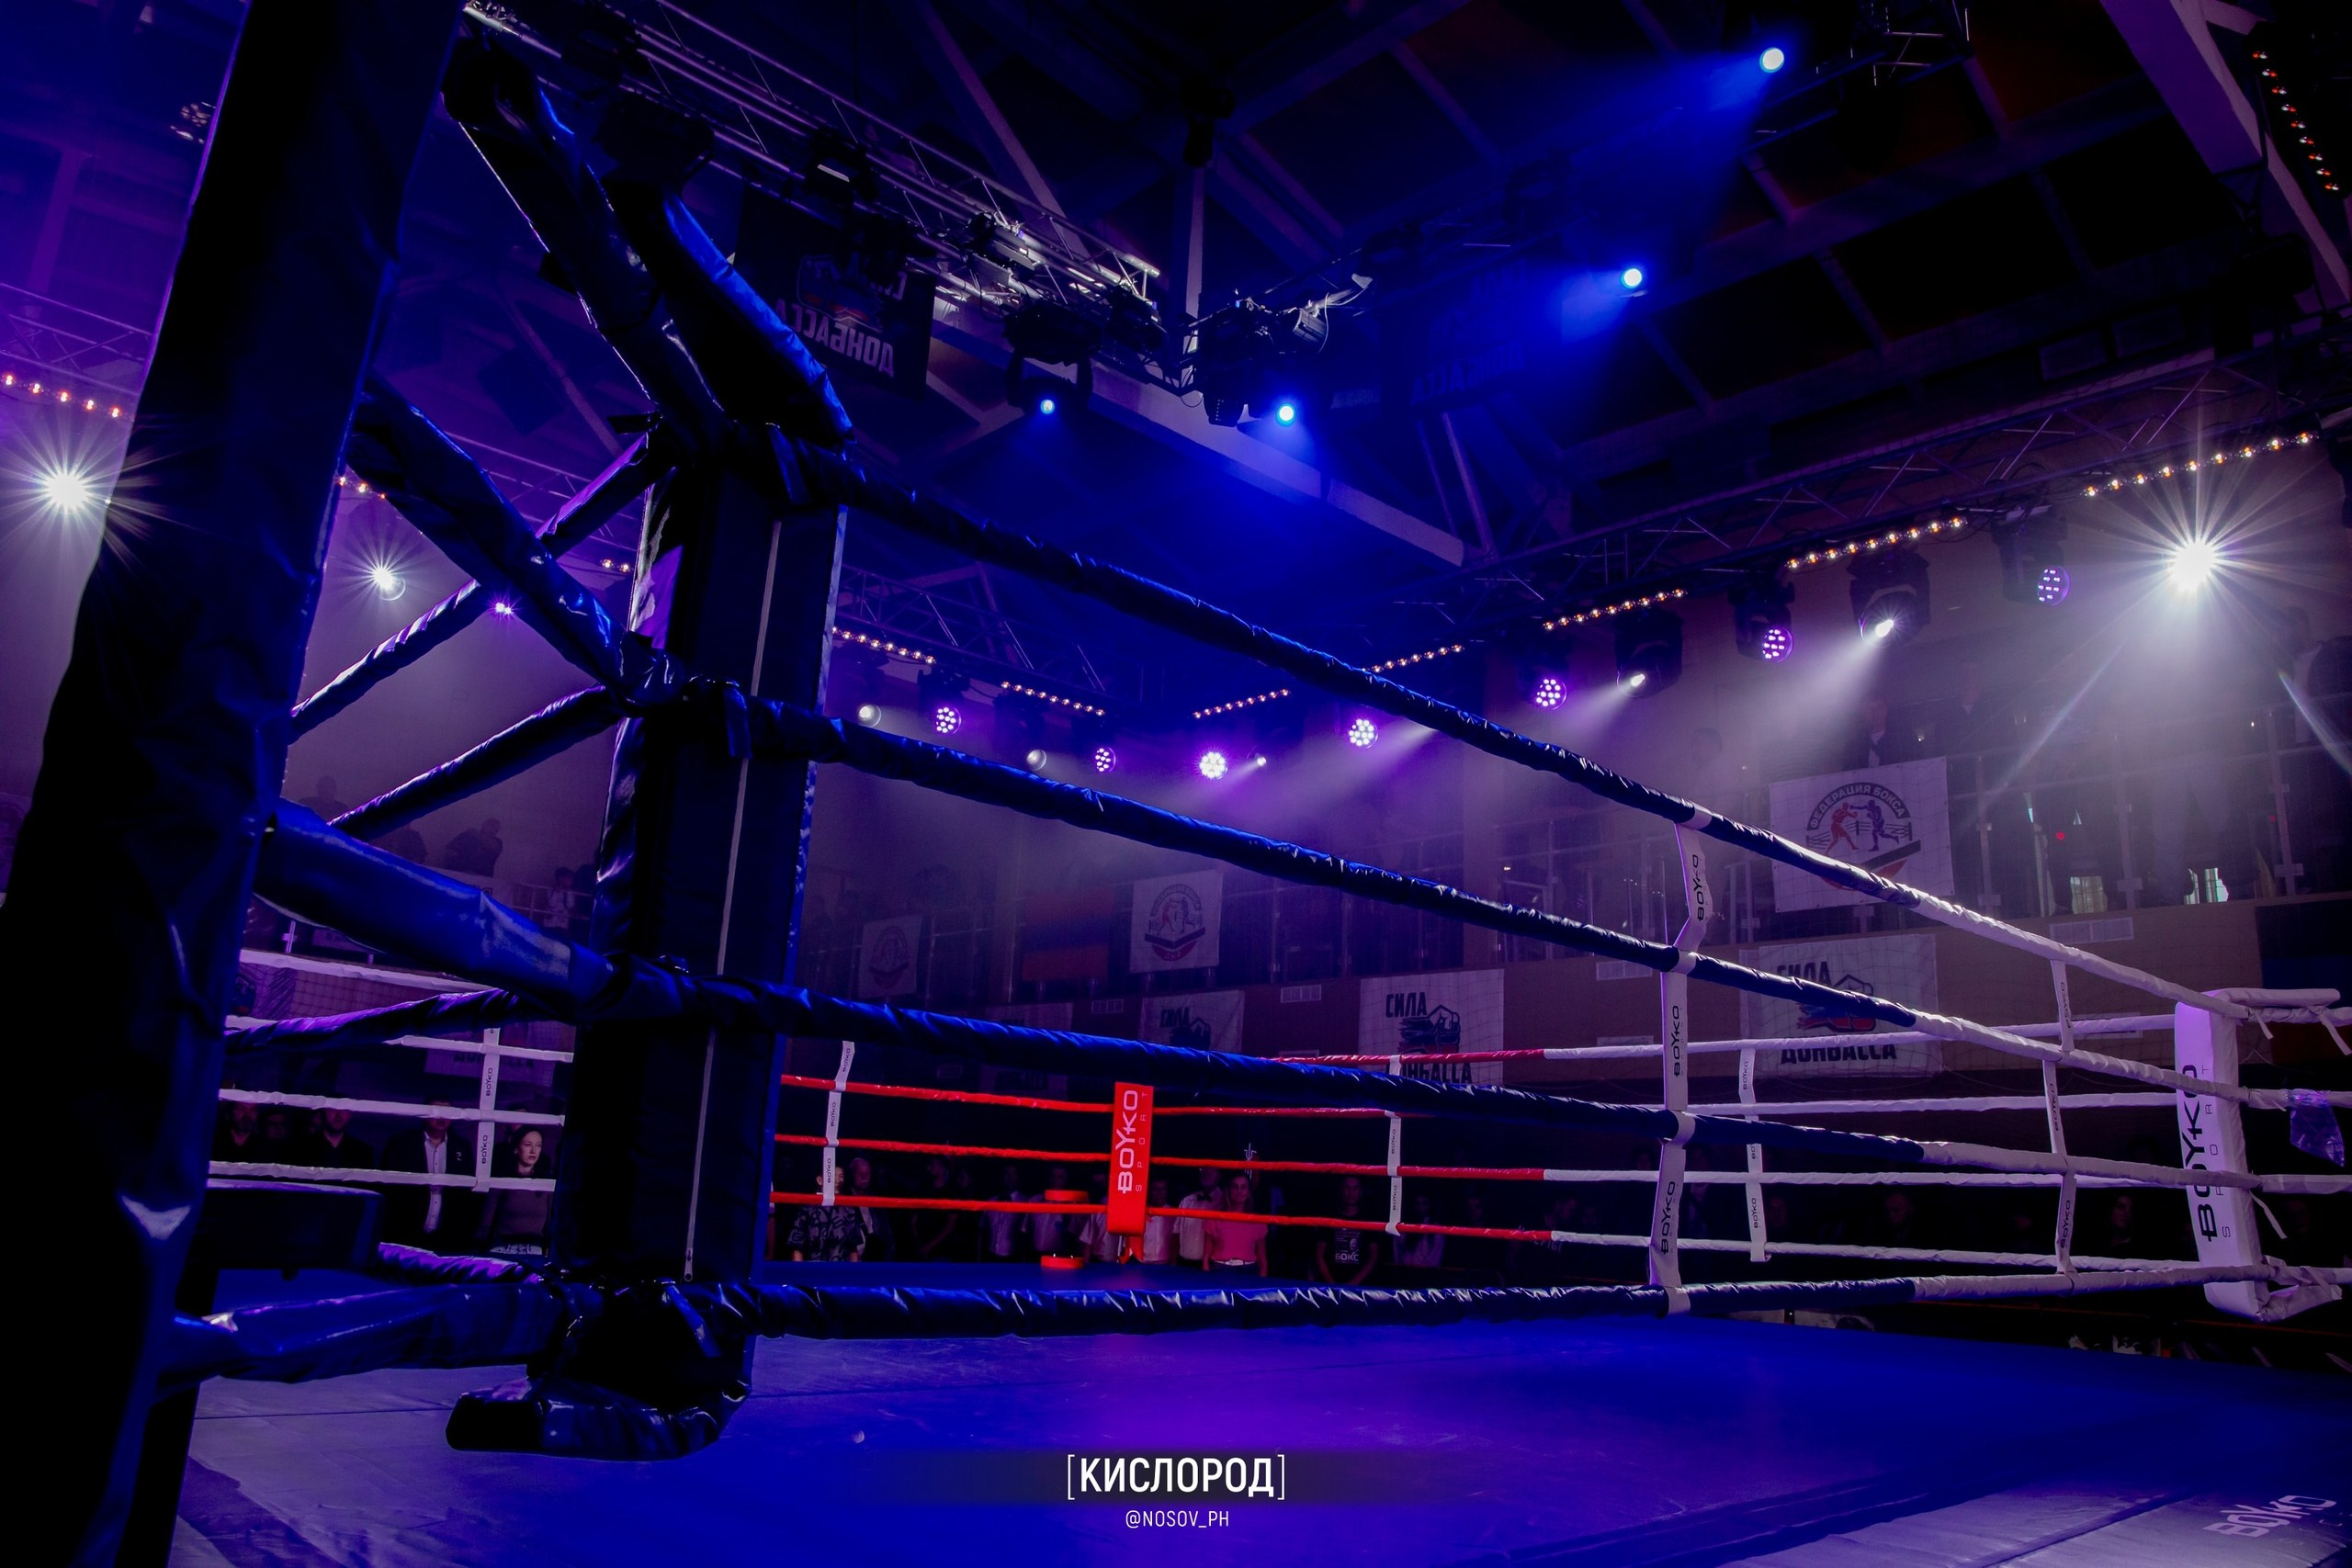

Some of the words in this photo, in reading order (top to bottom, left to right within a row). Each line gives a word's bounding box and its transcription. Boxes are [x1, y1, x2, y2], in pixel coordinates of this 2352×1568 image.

[1809, 784, 1871, 829] ФЕДЕРАЦИЯ
[1873, 786, 1905, 818] БОКСА
[1385, 992, 1427, 1018] СИЛА
[1671, 1005, 1680, 1077] BOYKO
[485, 1067, 493, 1097] BOYKO
[1115, 1089, 1138, 1194] BOYKO
[1136, 1092, 1148, 1192] SPORT
[1661, 1181, 1676, 1255] BOYKO
[2061, 1200, 2071, 1248] BOYKO
